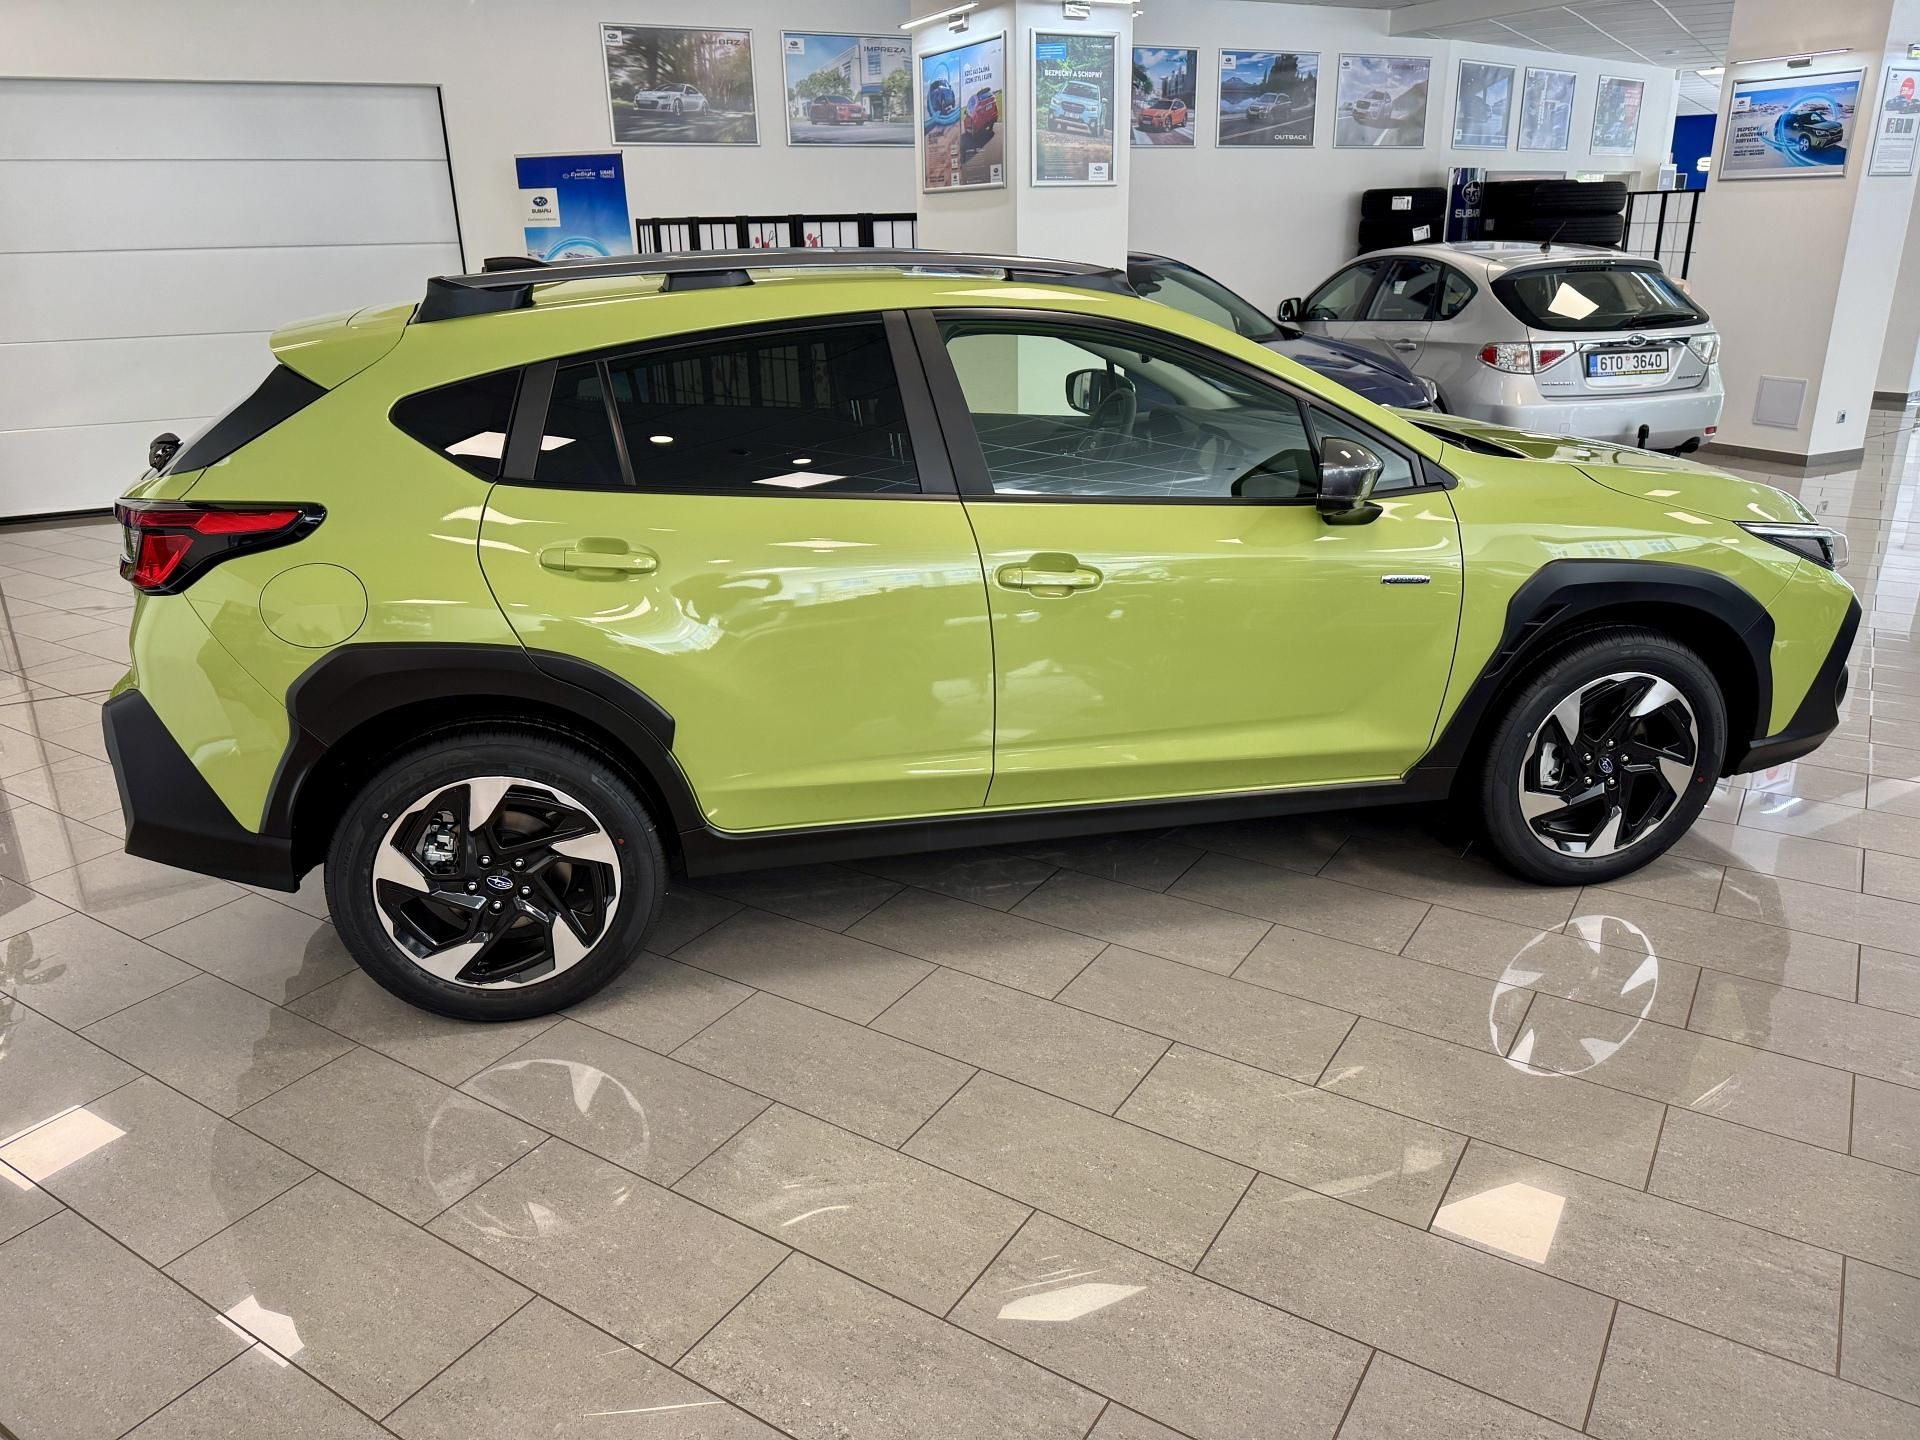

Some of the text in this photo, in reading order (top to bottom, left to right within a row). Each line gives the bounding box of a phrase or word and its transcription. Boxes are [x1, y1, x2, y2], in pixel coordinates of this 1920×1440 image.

[1044, 68, 1072, 77] BEZPEČNÝ
[1078, 70, 1103, 79] SCHOPNÝ
[1455, 208, 1481, 218] SUBAR
[1600, 353, 1662, 371] 6T0 3640
